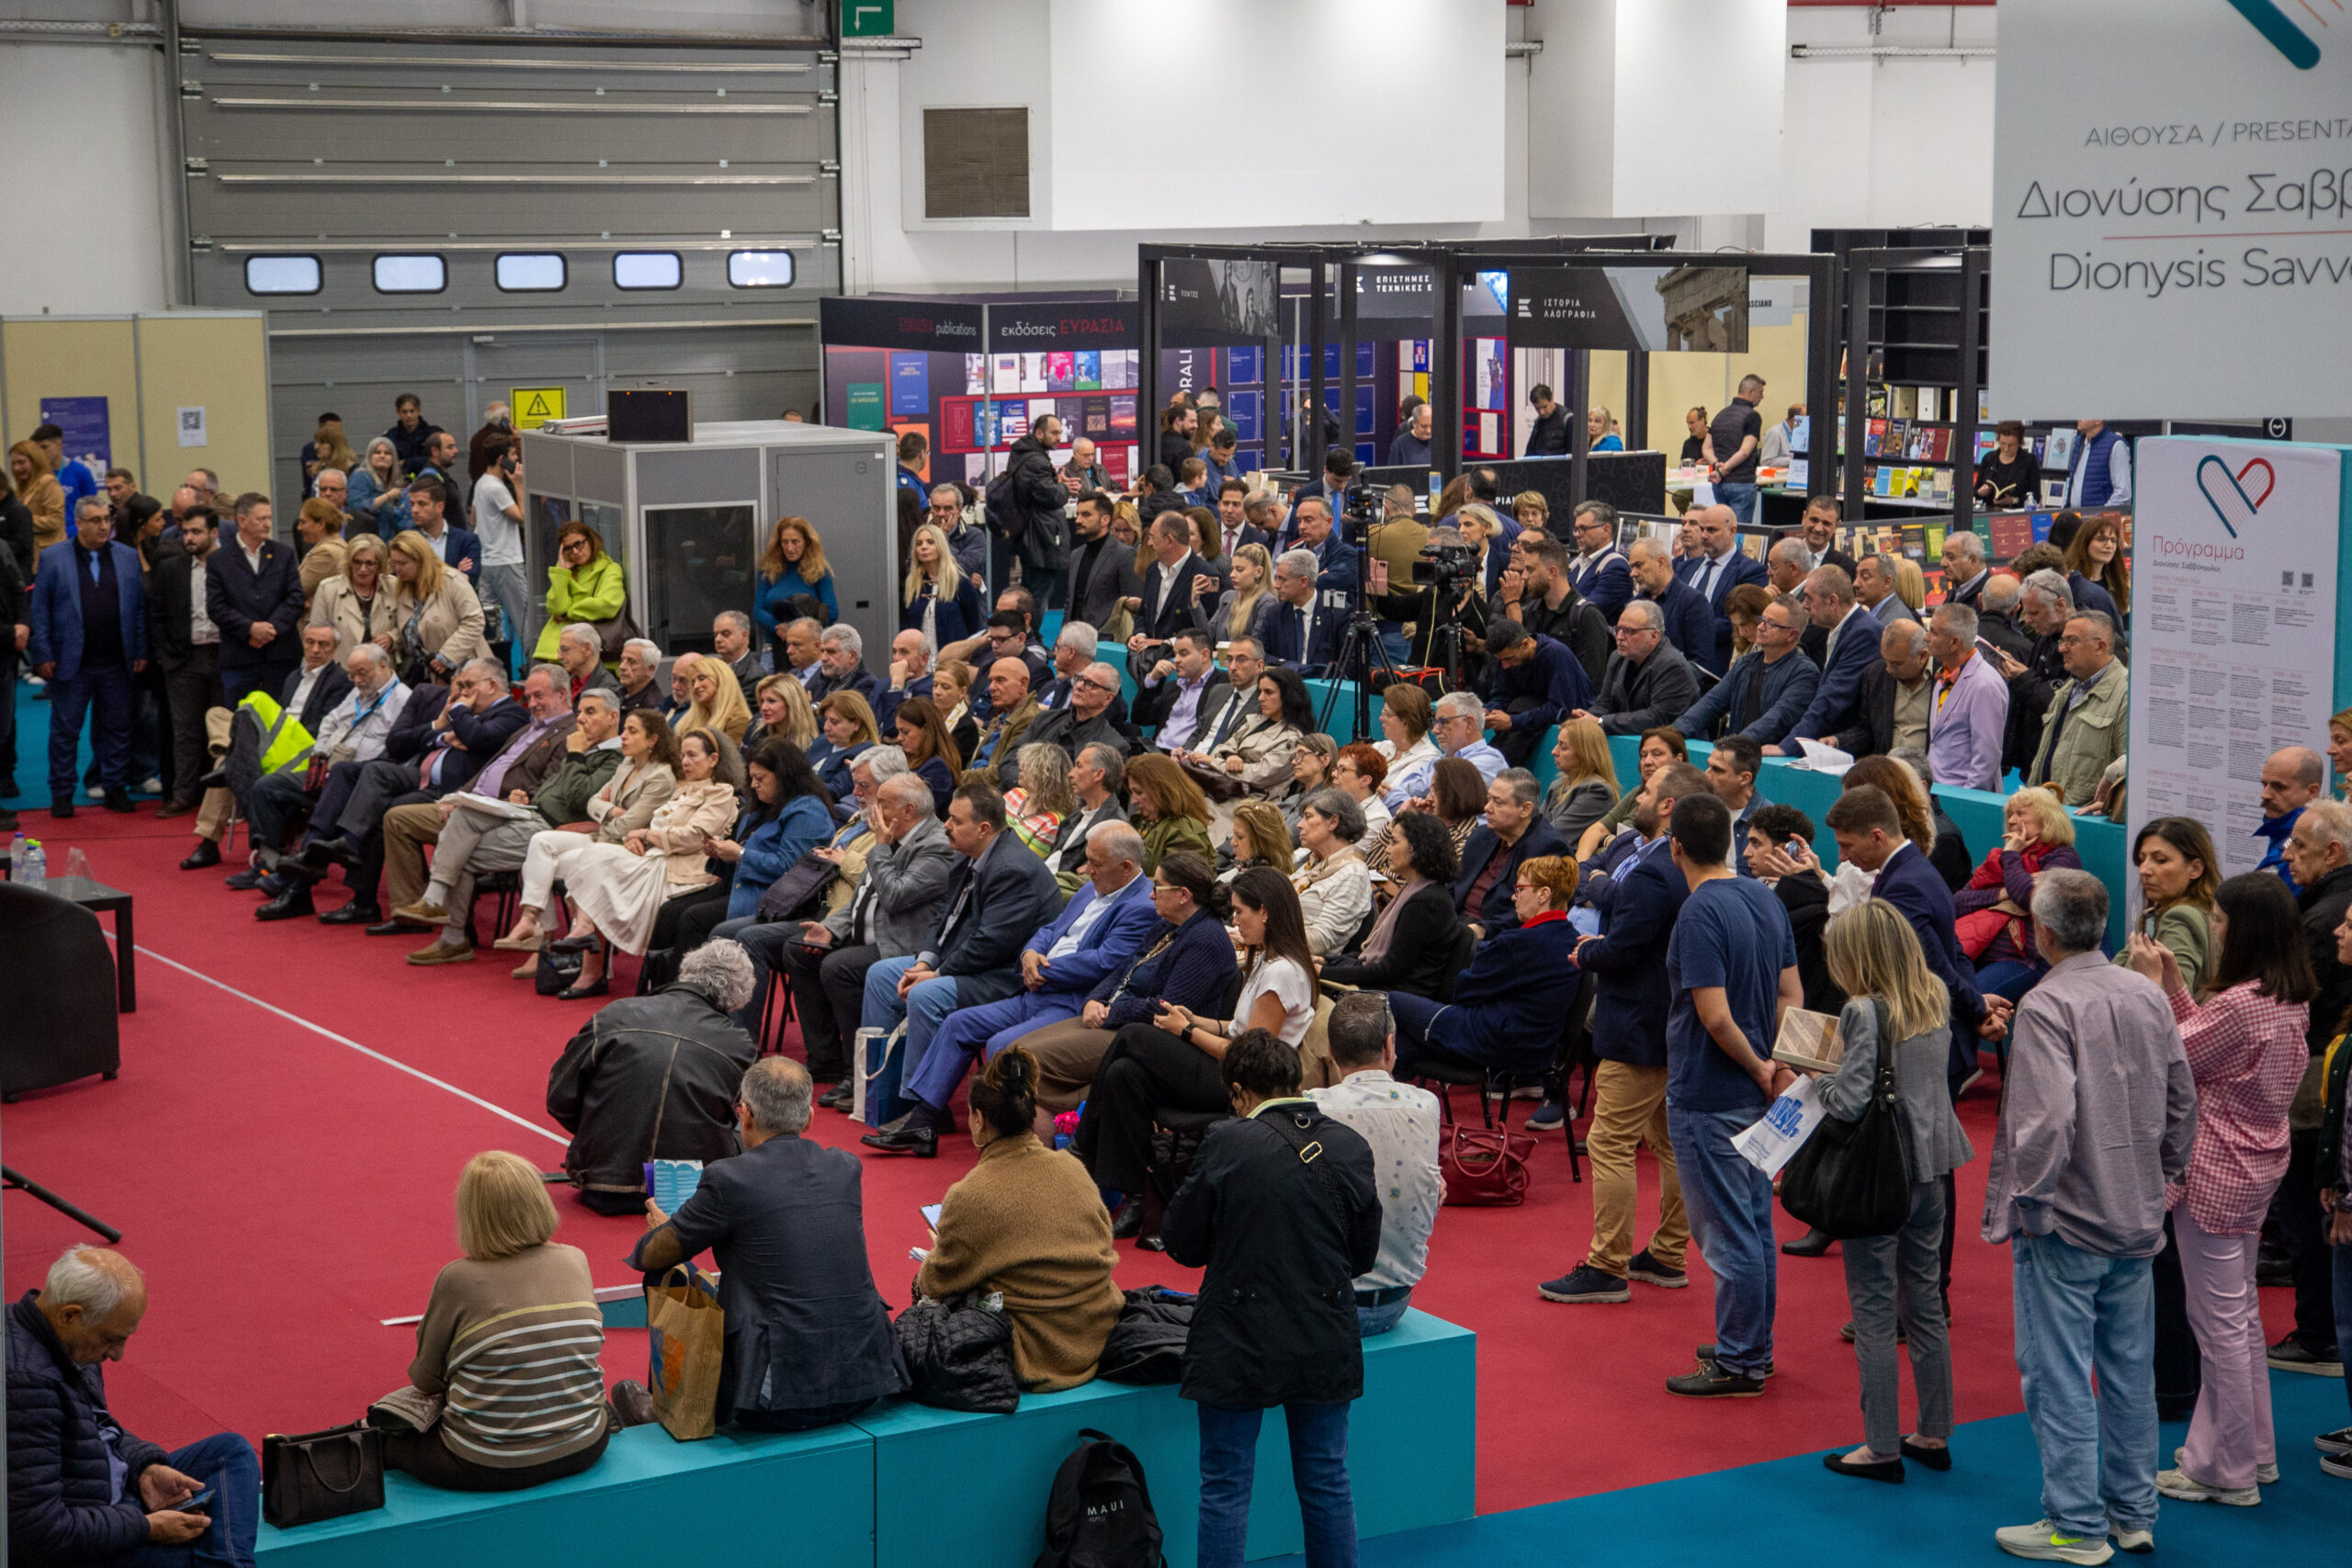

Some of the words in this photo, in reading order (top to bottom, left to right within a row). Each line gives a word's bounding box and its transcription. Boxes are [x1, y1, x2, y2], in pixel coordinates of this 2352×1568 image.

[2085, 123, 2204, 147] ΑΙΘΟΥΣΑ
[2017, 175, 2230, 223] Διονύσης
[1375, 275, 1430, 284] ΕΠΙΣΤΗΜΕΣ
[2050, 248, 2227, 299] Dionysis
[2242, 247, 2352, 288] Savv
[1375, 284, 1423, 293] ΤΕΧΝΙΚΕΣ
[1544, 298, 1581, 307] ΙΣΤΟΡΙΑ
[1544, 310, 1597, 319] ΛΑΟΓΡΑΦΙΑ
[1001, 321, 1057, 337] εκδόσεις
[1059, 318, 1125, 335] ΕΥΡΑΣΙΑ
[2153, 535, 2245, 563] Πρόγραμμα
[1087, 1499, 1124, 1517] MAUI
